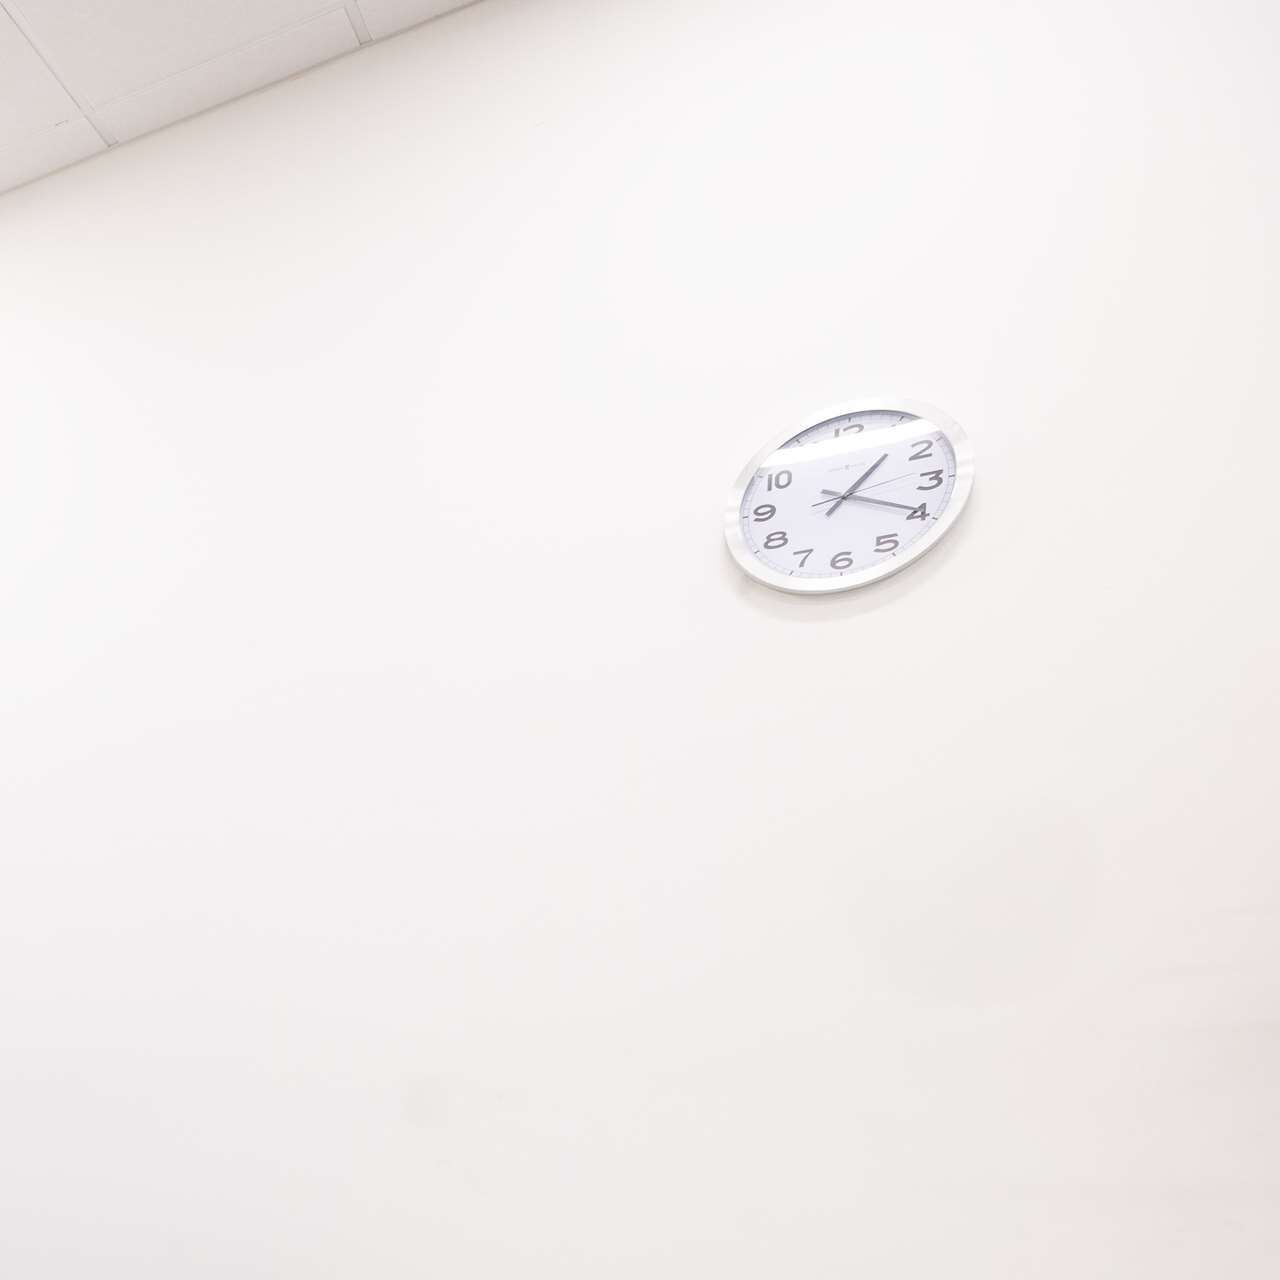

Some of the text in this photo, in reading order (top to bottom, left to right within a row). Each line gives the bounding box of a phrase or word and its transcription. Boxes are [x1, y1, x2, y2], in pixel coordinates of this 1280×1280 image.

[908, 440, 934, 461] 2
[766, 470, 792, 491] 10
[916, 469, 944, 491] 3
[753, 504, 777, 522] 9
[905, 503, 930, 521] 4
[763, 531, 789, 550] 8
[873, 533, 899, 553] 5
[792, 549, 814, 568] 7
[830, 552, 853, 570] 6
